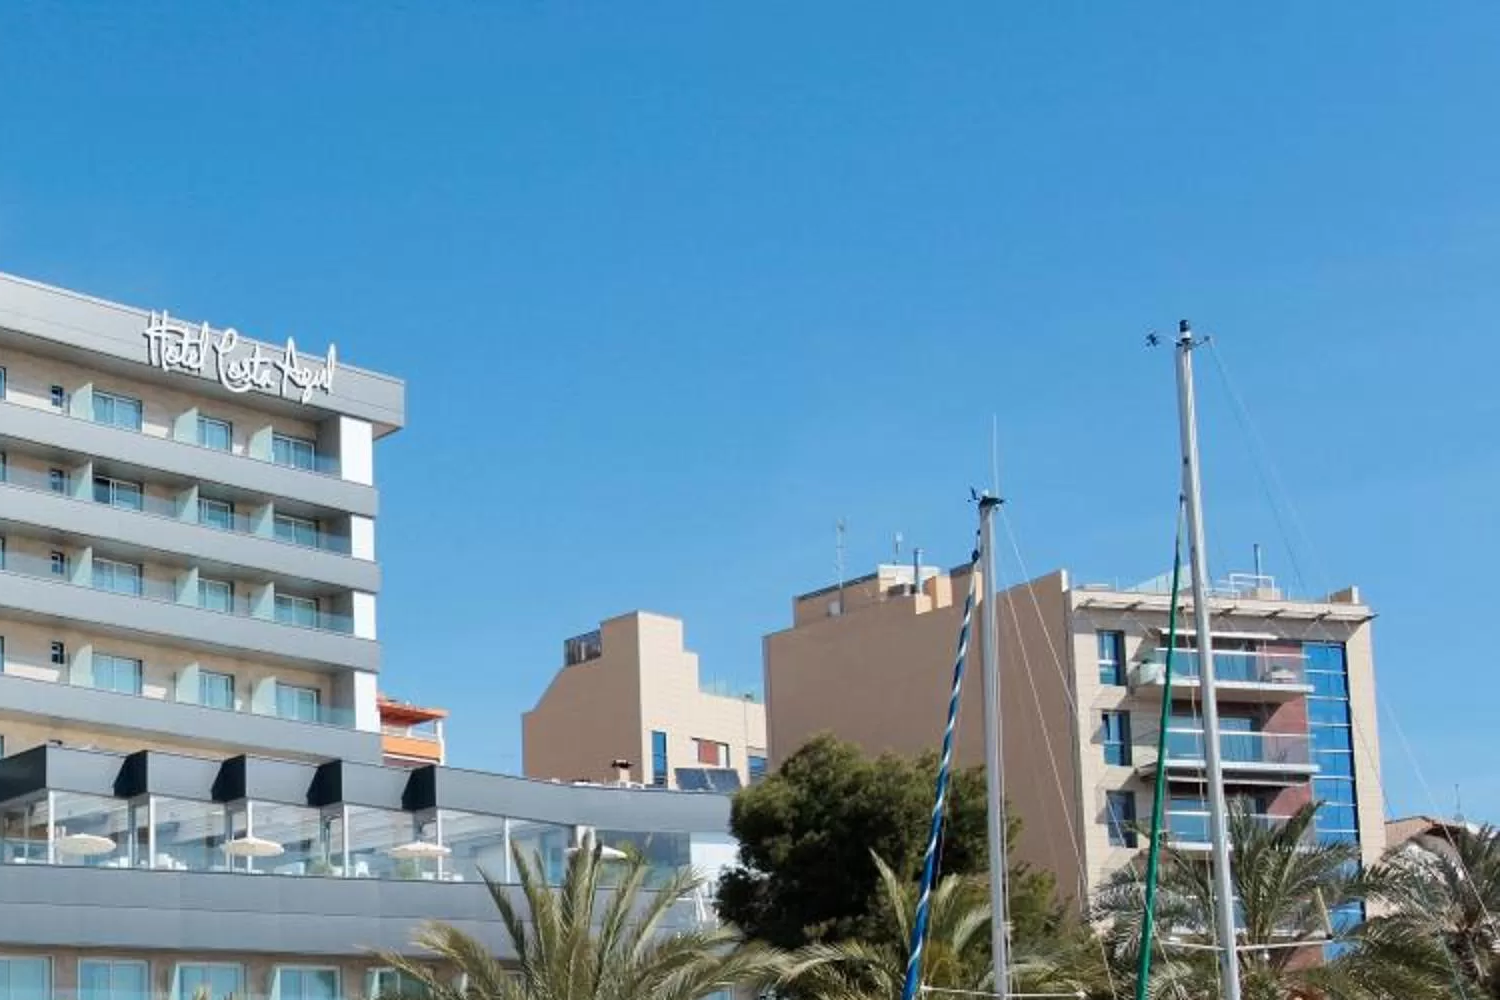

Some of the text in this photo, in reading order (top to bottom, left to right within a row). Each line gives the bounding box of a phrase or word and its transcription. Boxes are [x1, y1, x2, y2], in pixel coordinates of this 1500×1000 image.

[144, 309, 337, 403] Hotel Costa Azul
